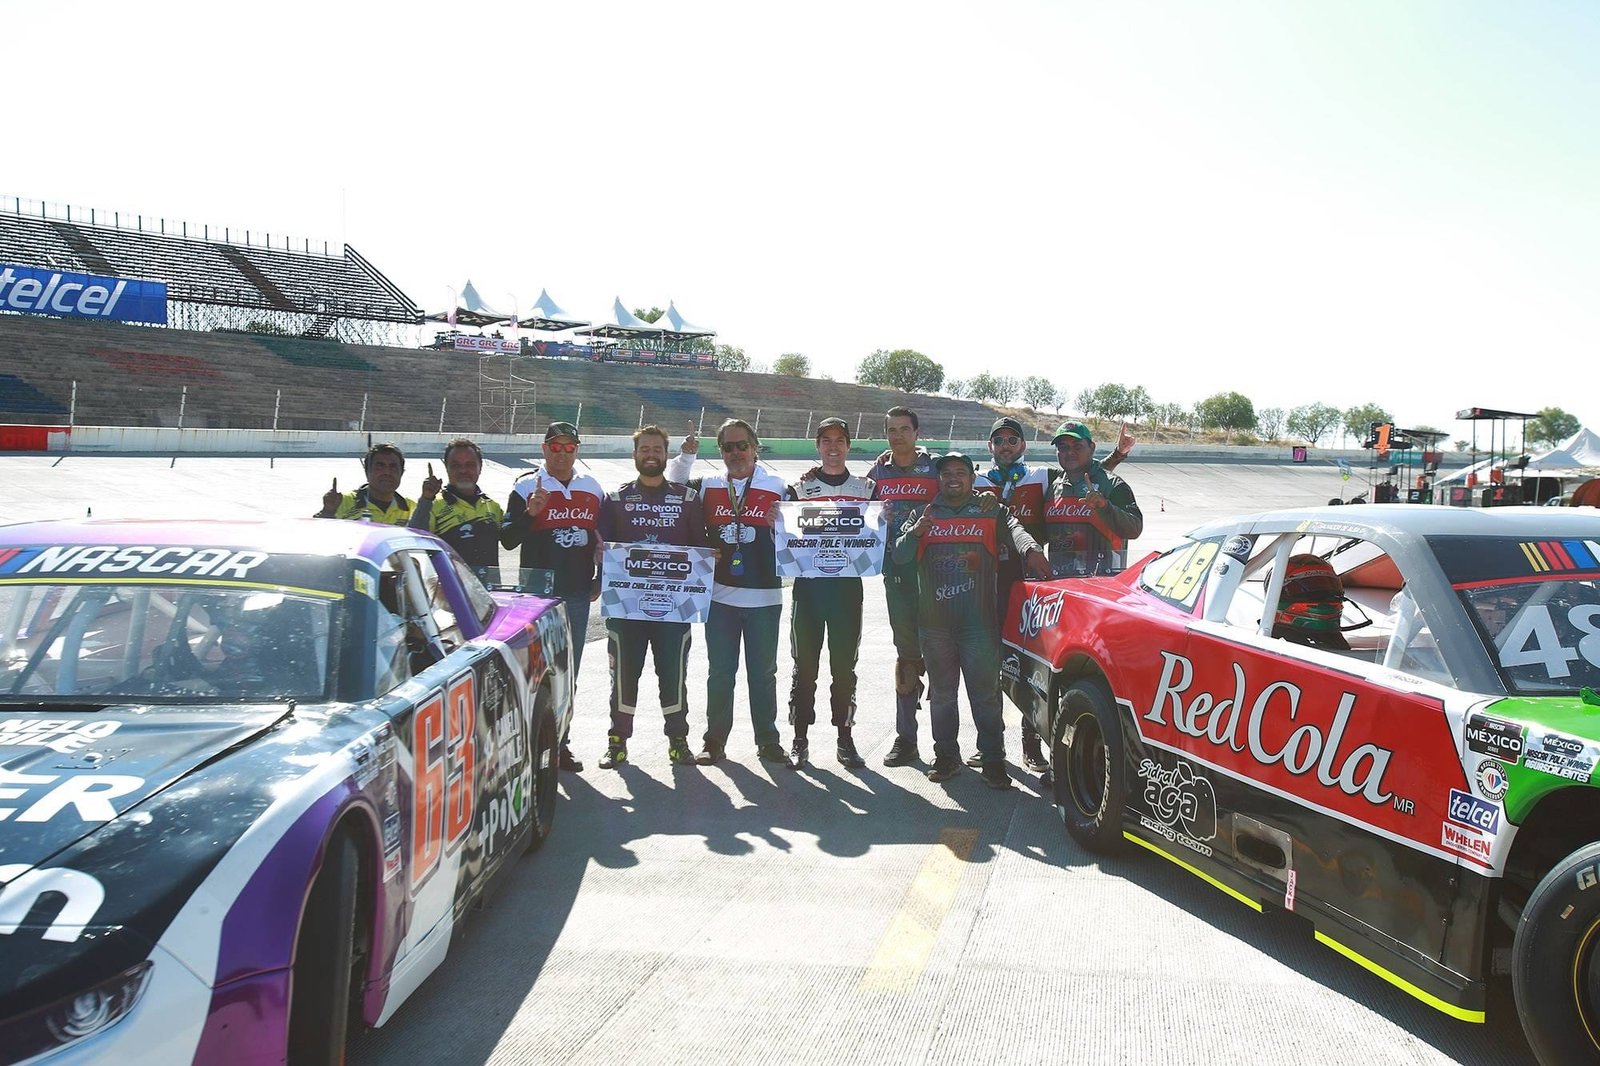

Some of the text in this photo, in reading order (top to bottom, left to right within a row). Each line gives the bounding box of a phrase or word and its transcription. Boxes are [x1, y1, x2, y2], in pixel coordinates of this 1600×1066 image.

[0, 268, 127, 316] telcel
[456, 337, 476, 346] GRC
[478, 339, 498, 347] GRC
[500, 341, 519, 349] GRC
[880, 483, 927, 496] Red Cola
[1411, 491, 1420, 500] 2
[547, 508, 594, 521] Red Cola
[799, 515, 863, 526] MÉXICO
[1066, 504, 1092, 516] Cola
[929, 522, 984, 537] Red Cola
[787, 539, 875, 548] NASCAR POLE WINNER
[17, 546, 269, 578] NASCAR
[626, 559, 690, 572] MÉXICO
[608, 581, 707, 594] NASCAR CHALLENGE POLE WINNER
[1498, 604, 1600, 678] 48
[1143, 650, 1393, 805] Red Cola
[1467, 727, 1521, 751] MÉXICO
[1543, 737, 1582, 752] MÉXICO
[1138, 758, 1180, 786] Sidral
[1524, 759, 1590, 783] AGUASCALIENTES
[1526, 748, 1593, 772] NASCAR POLE WINNER
[413, 674, 474, 888] 63
[1144, 779, 1198, 826] aga
[1393, 796, 1415, 816] MR
[1452, 794, 1499, 830] telcel
[1140, 815, 1213, 857] racing team
[1444, 825, 1491, 856] WHELEN
